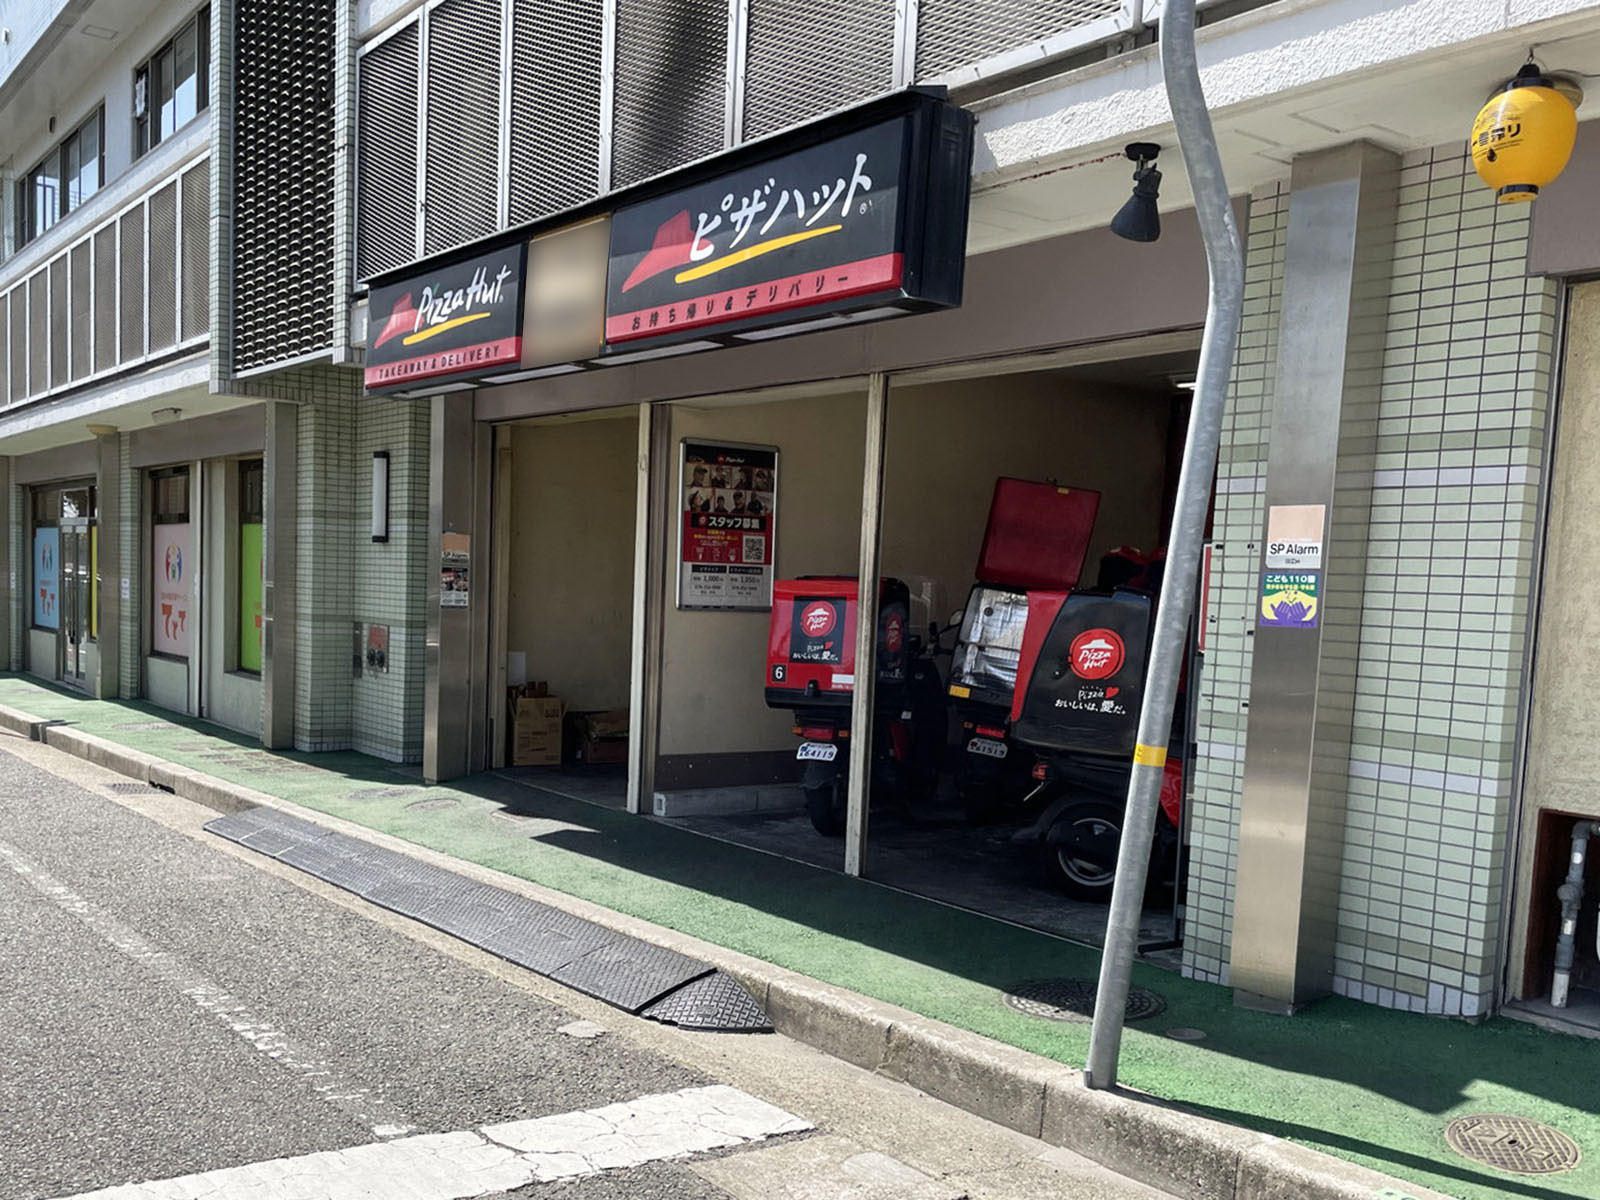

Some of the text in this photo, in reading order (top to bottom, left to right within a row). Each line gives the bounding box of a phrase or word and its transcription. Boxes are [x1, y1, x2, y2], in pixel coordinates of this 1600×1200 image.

[690, 153, 872, 261] ピザハット
[413, 264, 512, 333] Pizza Hut
[378, 360, 428, 380] TAKEAWAY
[440, 345, 500, 367] DELIVERY
[1269, 543, 1319, 555] SP Alarm
[1078, 648, 1112, 663] Pizza
[1083, 658, 1109, 670] Hut
[775, 666, 783, 680] 6
[1077, 687, 1105, 701] Pizza
